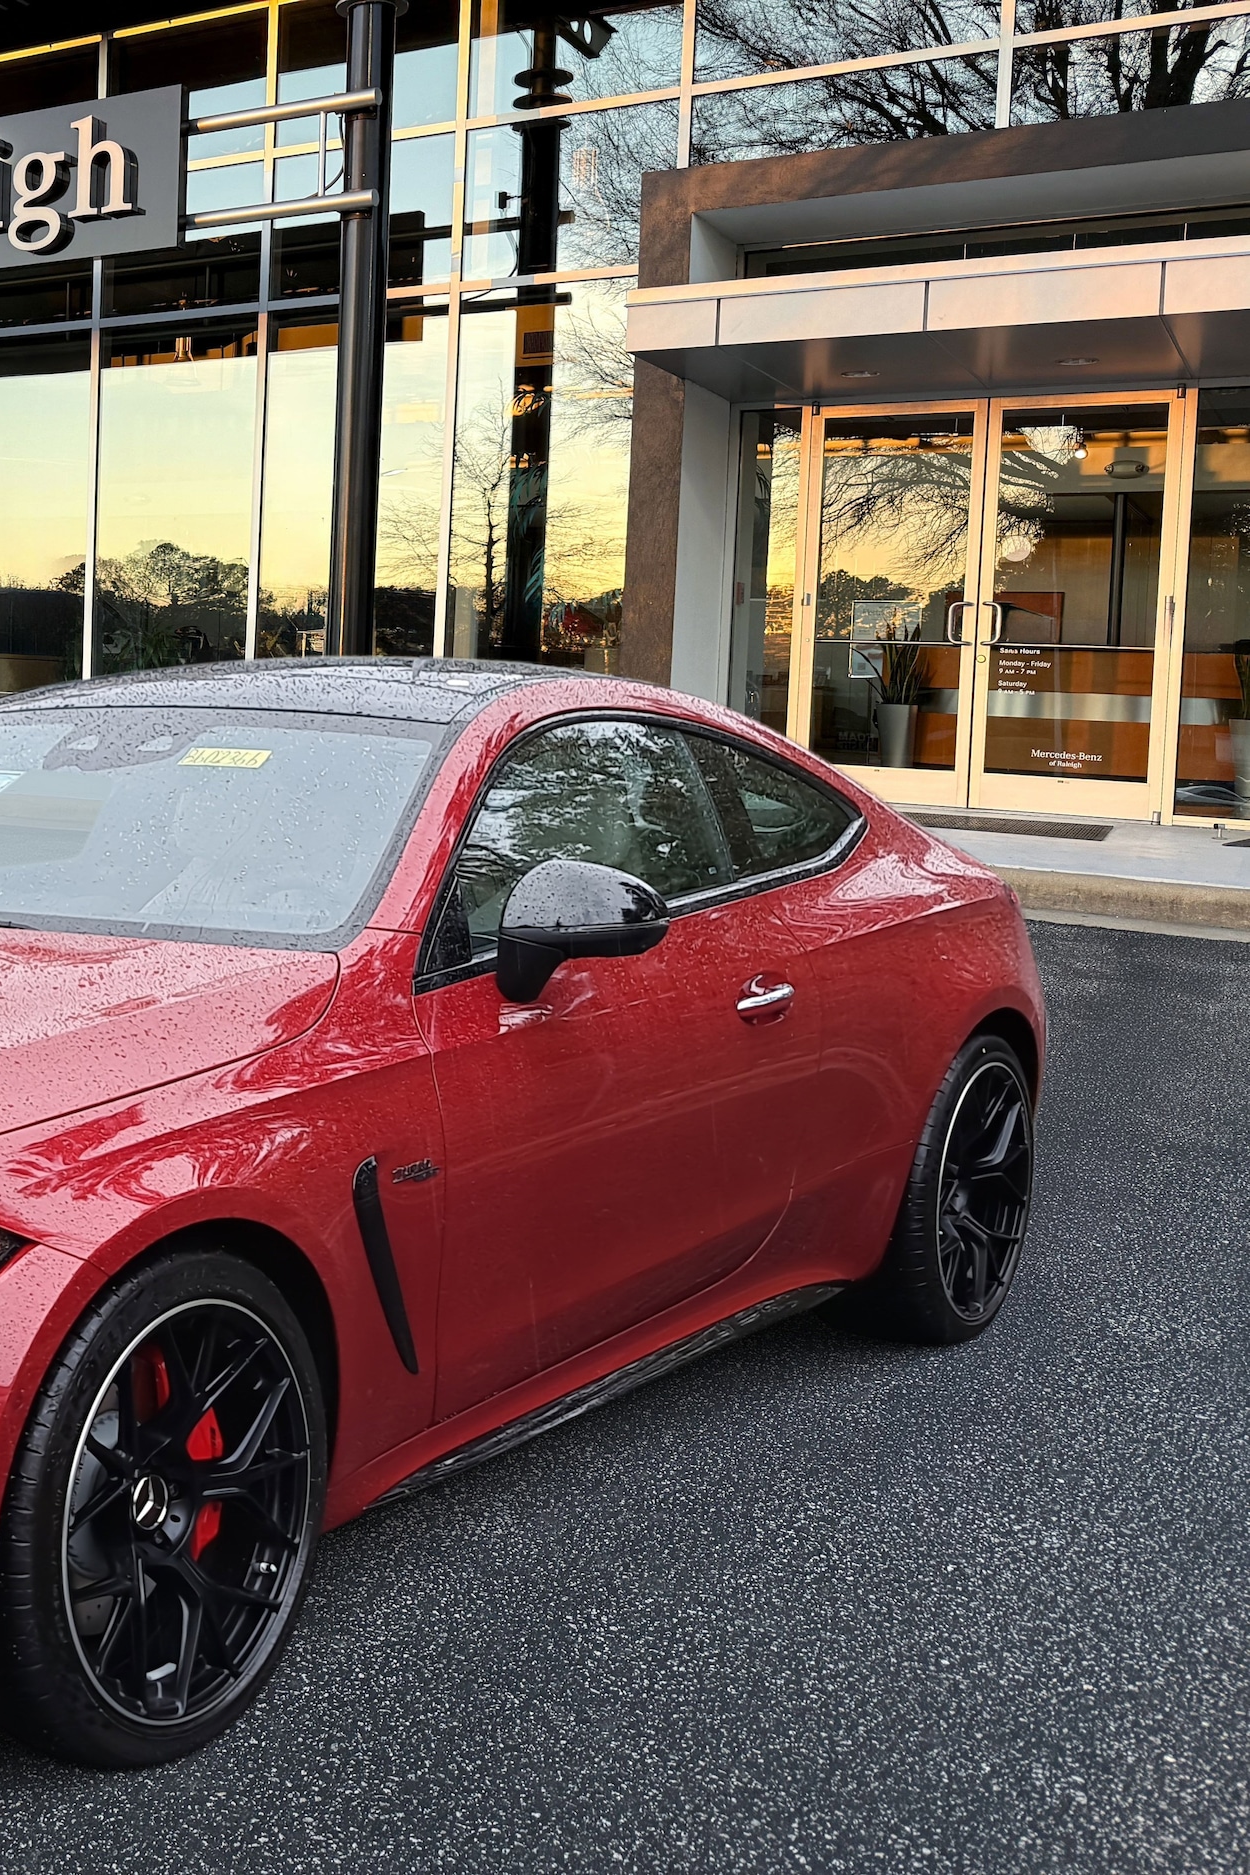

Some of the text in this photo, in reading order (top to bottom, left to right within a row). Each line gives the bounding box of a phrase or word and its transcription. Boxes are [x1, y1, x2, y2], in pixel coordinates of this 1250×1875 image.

[999, 660, 1025, 668] Monday
[1030, 660, 1051, 669] Friday
[998, 680, 1027, 688] Saturday
[1031, 748, 1103, 762] Mercedes-Benz
[1057, 760, 1083, 769] Raleigh
